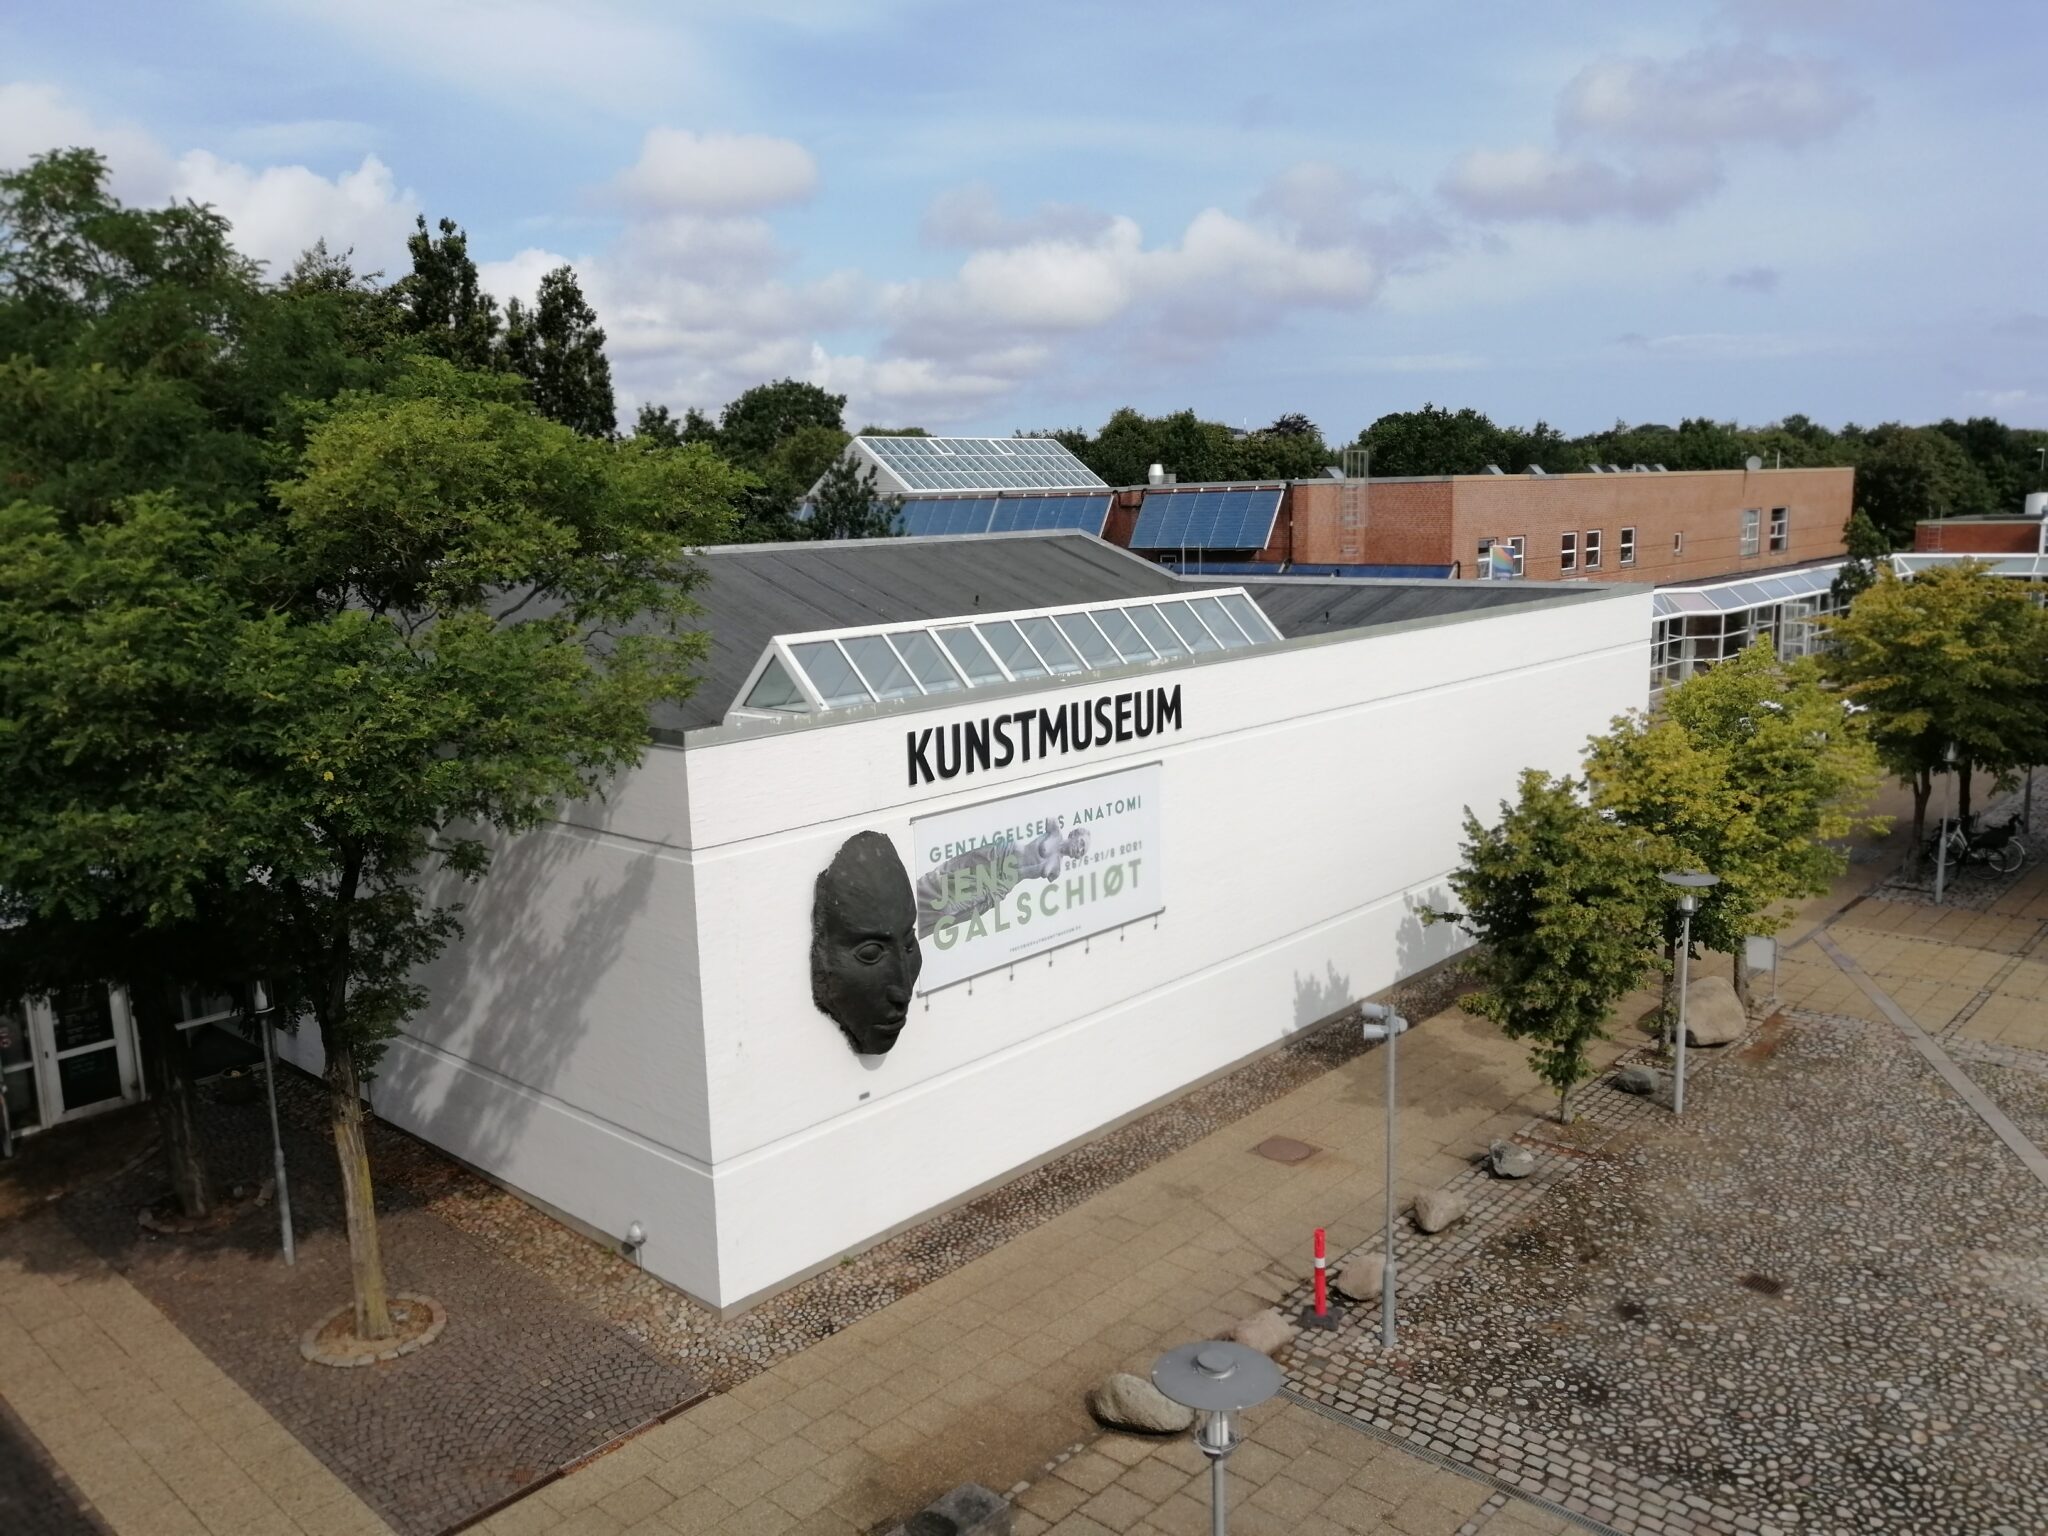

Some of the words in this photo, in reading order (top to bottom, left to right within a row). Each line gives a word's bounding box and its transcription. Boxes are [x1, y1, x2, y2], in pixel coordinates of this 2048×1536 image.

[907, 684, 1182, 786] KUNSTMUSEUM
[1072, 795, 1142, 826] ANATOMI
[1120, 840, 1142, 855] 2021
[931, 855, 1019, 911] JENS
[933, 858, 1142, 951] GALSCHIØT
